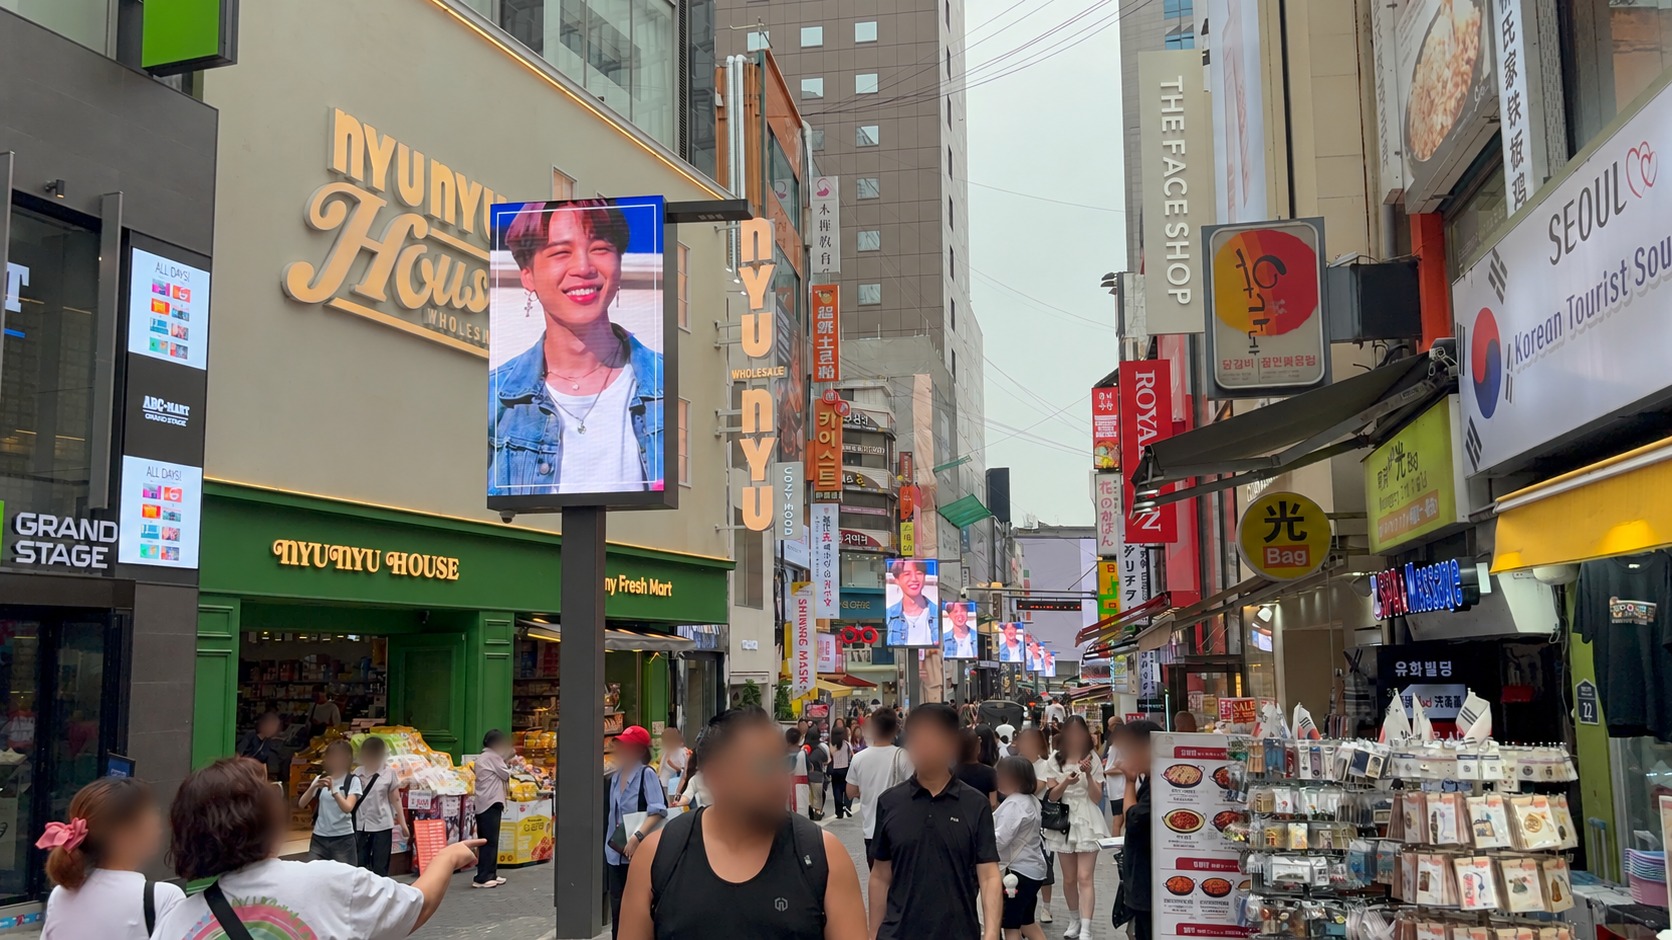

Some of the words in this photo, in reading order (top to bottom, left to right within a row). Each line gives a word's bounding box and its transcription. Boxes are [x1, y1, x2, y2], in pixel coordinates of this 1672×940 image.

[1160, 75, 1185, 132] THE
[1162, 139, 1188, 216] FACE
[1548, 161, 1627, 266] SEOUL
[284, 181, 490, 313] Hous
[1165, 222, 1192, 305] SHOP
[155, 262, 169, 276] ALL
[170, 266, 191, 282] DAYS!
[425, 307, 490, 345] WHOLES
[1514, 310, 1562, 364] Korean
[1566, 258, 1628, 330] Tourist
[732, 366, 784, 379] WHOLESALE
[146, 466, 159, 478] ALL
[161, 468, 182, 481] DAYS!
[784, 467, 793, 500] COZY
[15, 511, 118, 543] GRAND
[1264, 501, 1307, 543] 光
[15, 540, 108, 569] STAGE
[272, 539, 381, 572] NYUNYU
[385, 551, 459, 581] HOUSE
[1267, 548, 1306, 565] Bag
[605, 577, 617, 596] ny
[619, 574, 647, 594] Fresh
[650, 578, 672, 597] Mart
[799, 650, 808, 684] MASK
[1395, 661, 1452, 677] 유화빌딩
[1233, 701, 1256, 712] SALE
